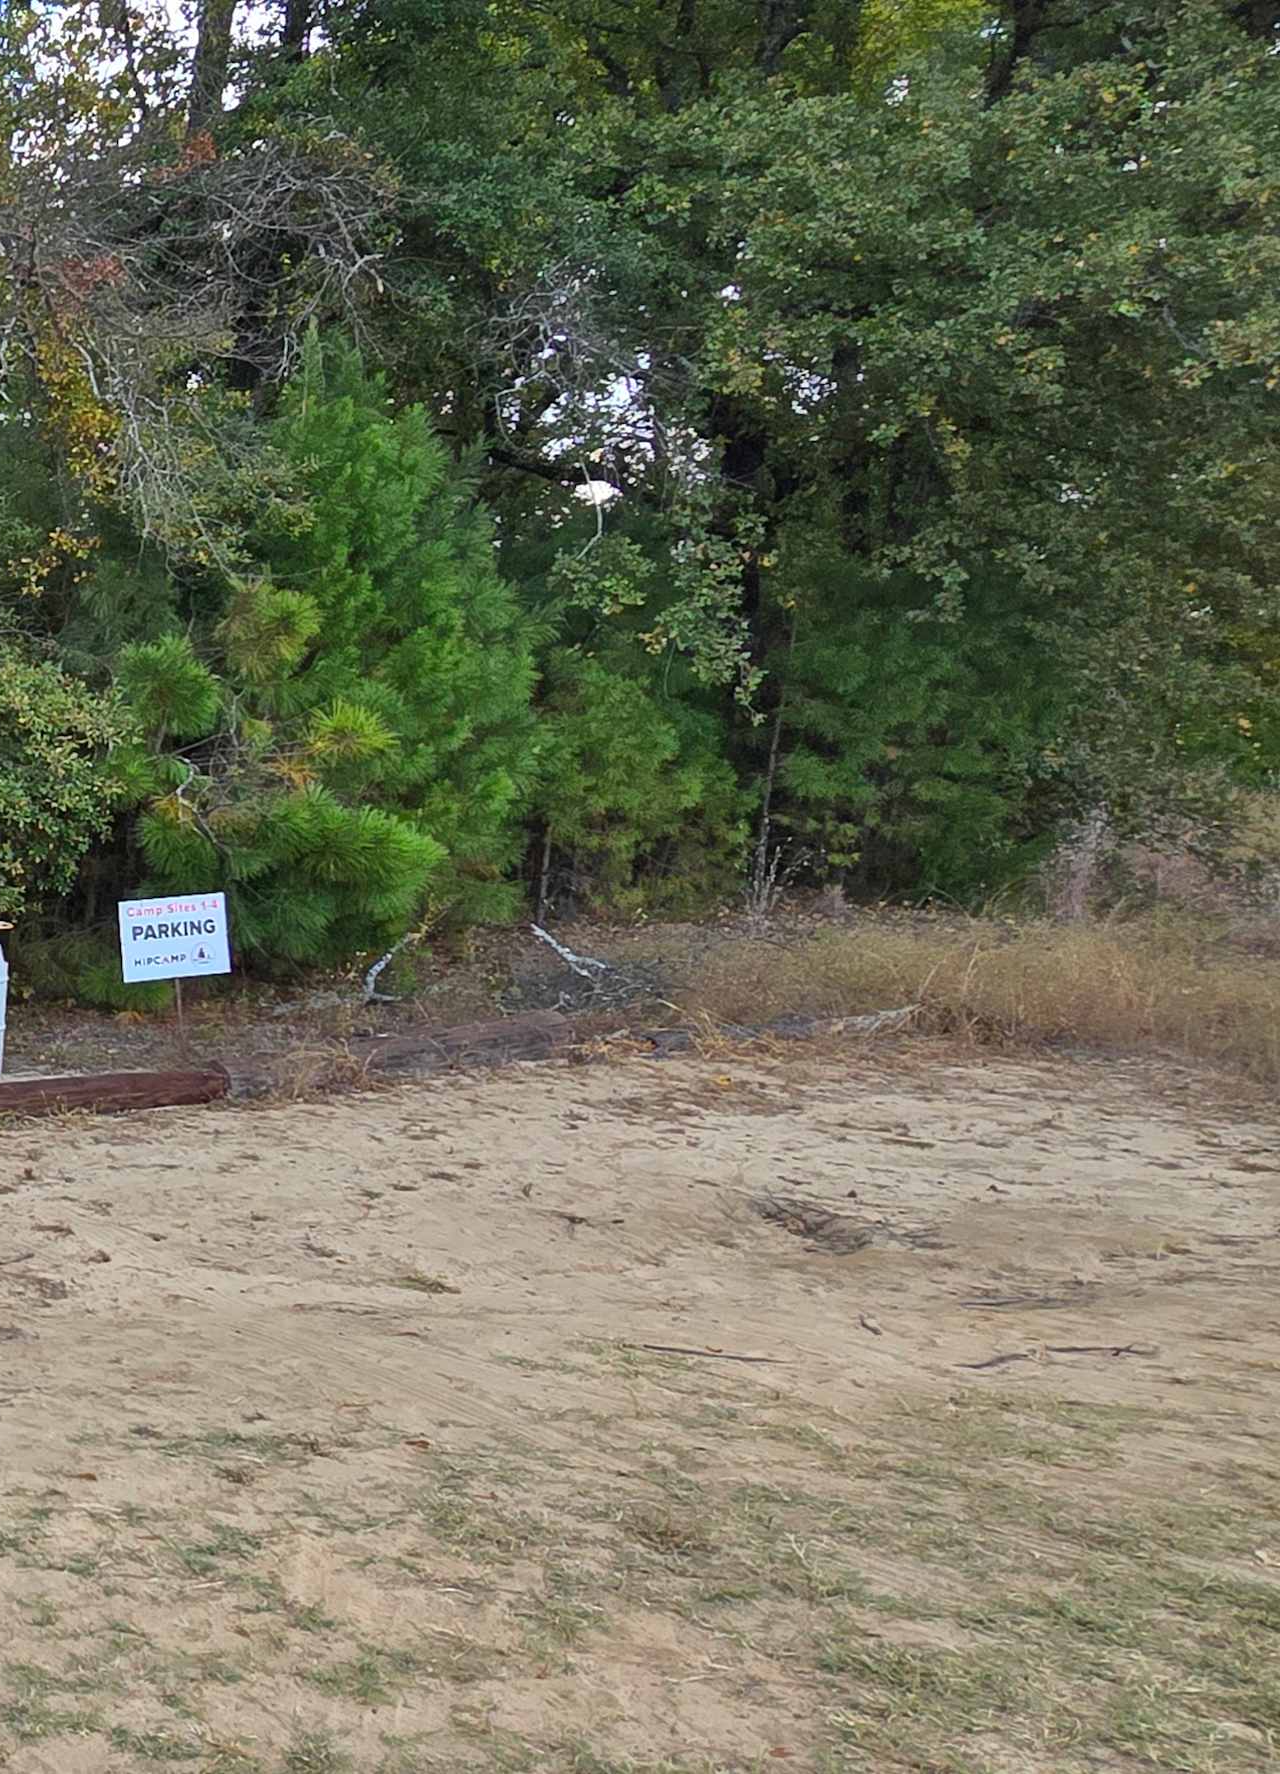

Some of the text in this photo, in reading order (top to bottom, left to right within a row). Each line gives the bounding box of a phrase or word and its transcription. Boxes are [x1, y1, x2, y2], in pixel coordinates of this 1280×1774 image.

[127, 906, 162, 917] Camp
[167, 903, 196, 913] Sites
[132, 919, 216, 941] PARKING
[134, 954, 186, 967] HIPCAMP
